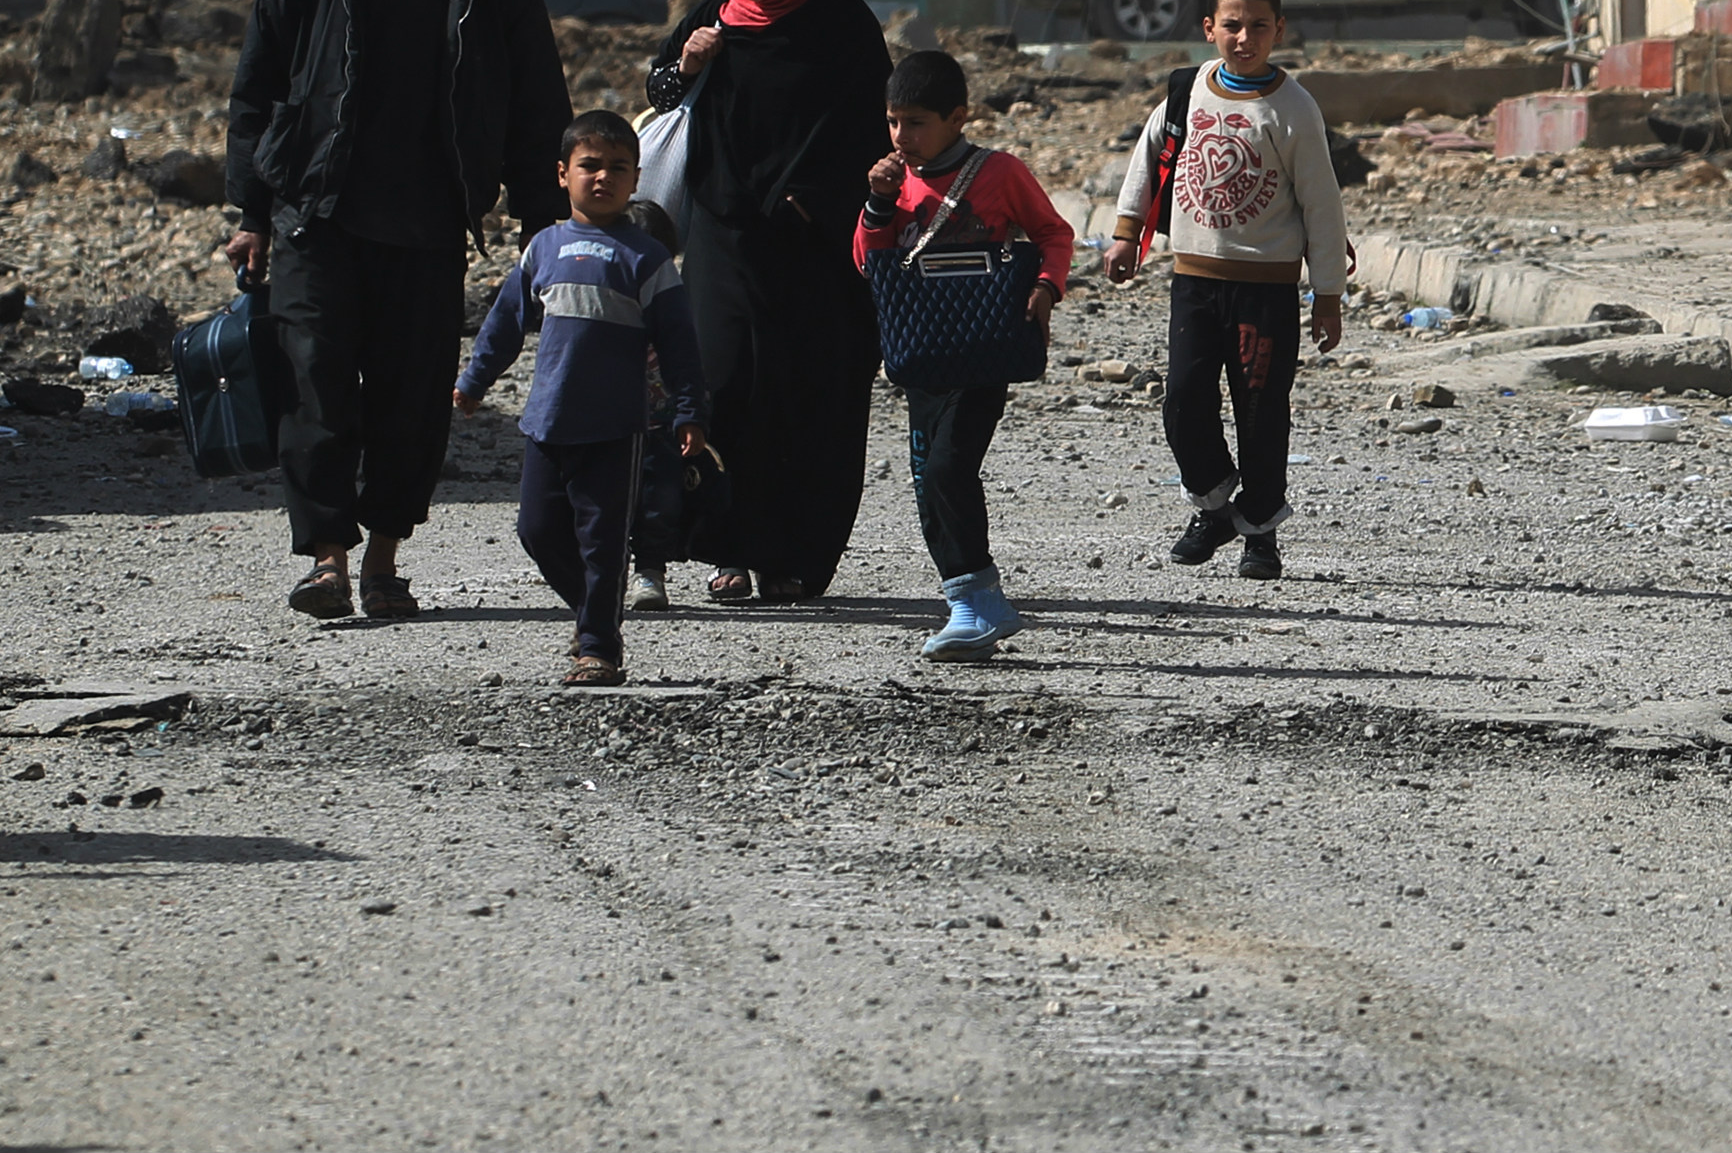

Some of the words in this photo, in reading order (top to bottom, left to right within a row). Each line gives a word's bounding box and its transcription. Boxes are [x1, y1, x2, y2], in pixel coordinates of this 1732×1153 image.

[1174, 173, 1196, 214] VERY
[1194, 209, 1232, 229] GLAD
[1235, 169, 1278, 225] SWEETS
